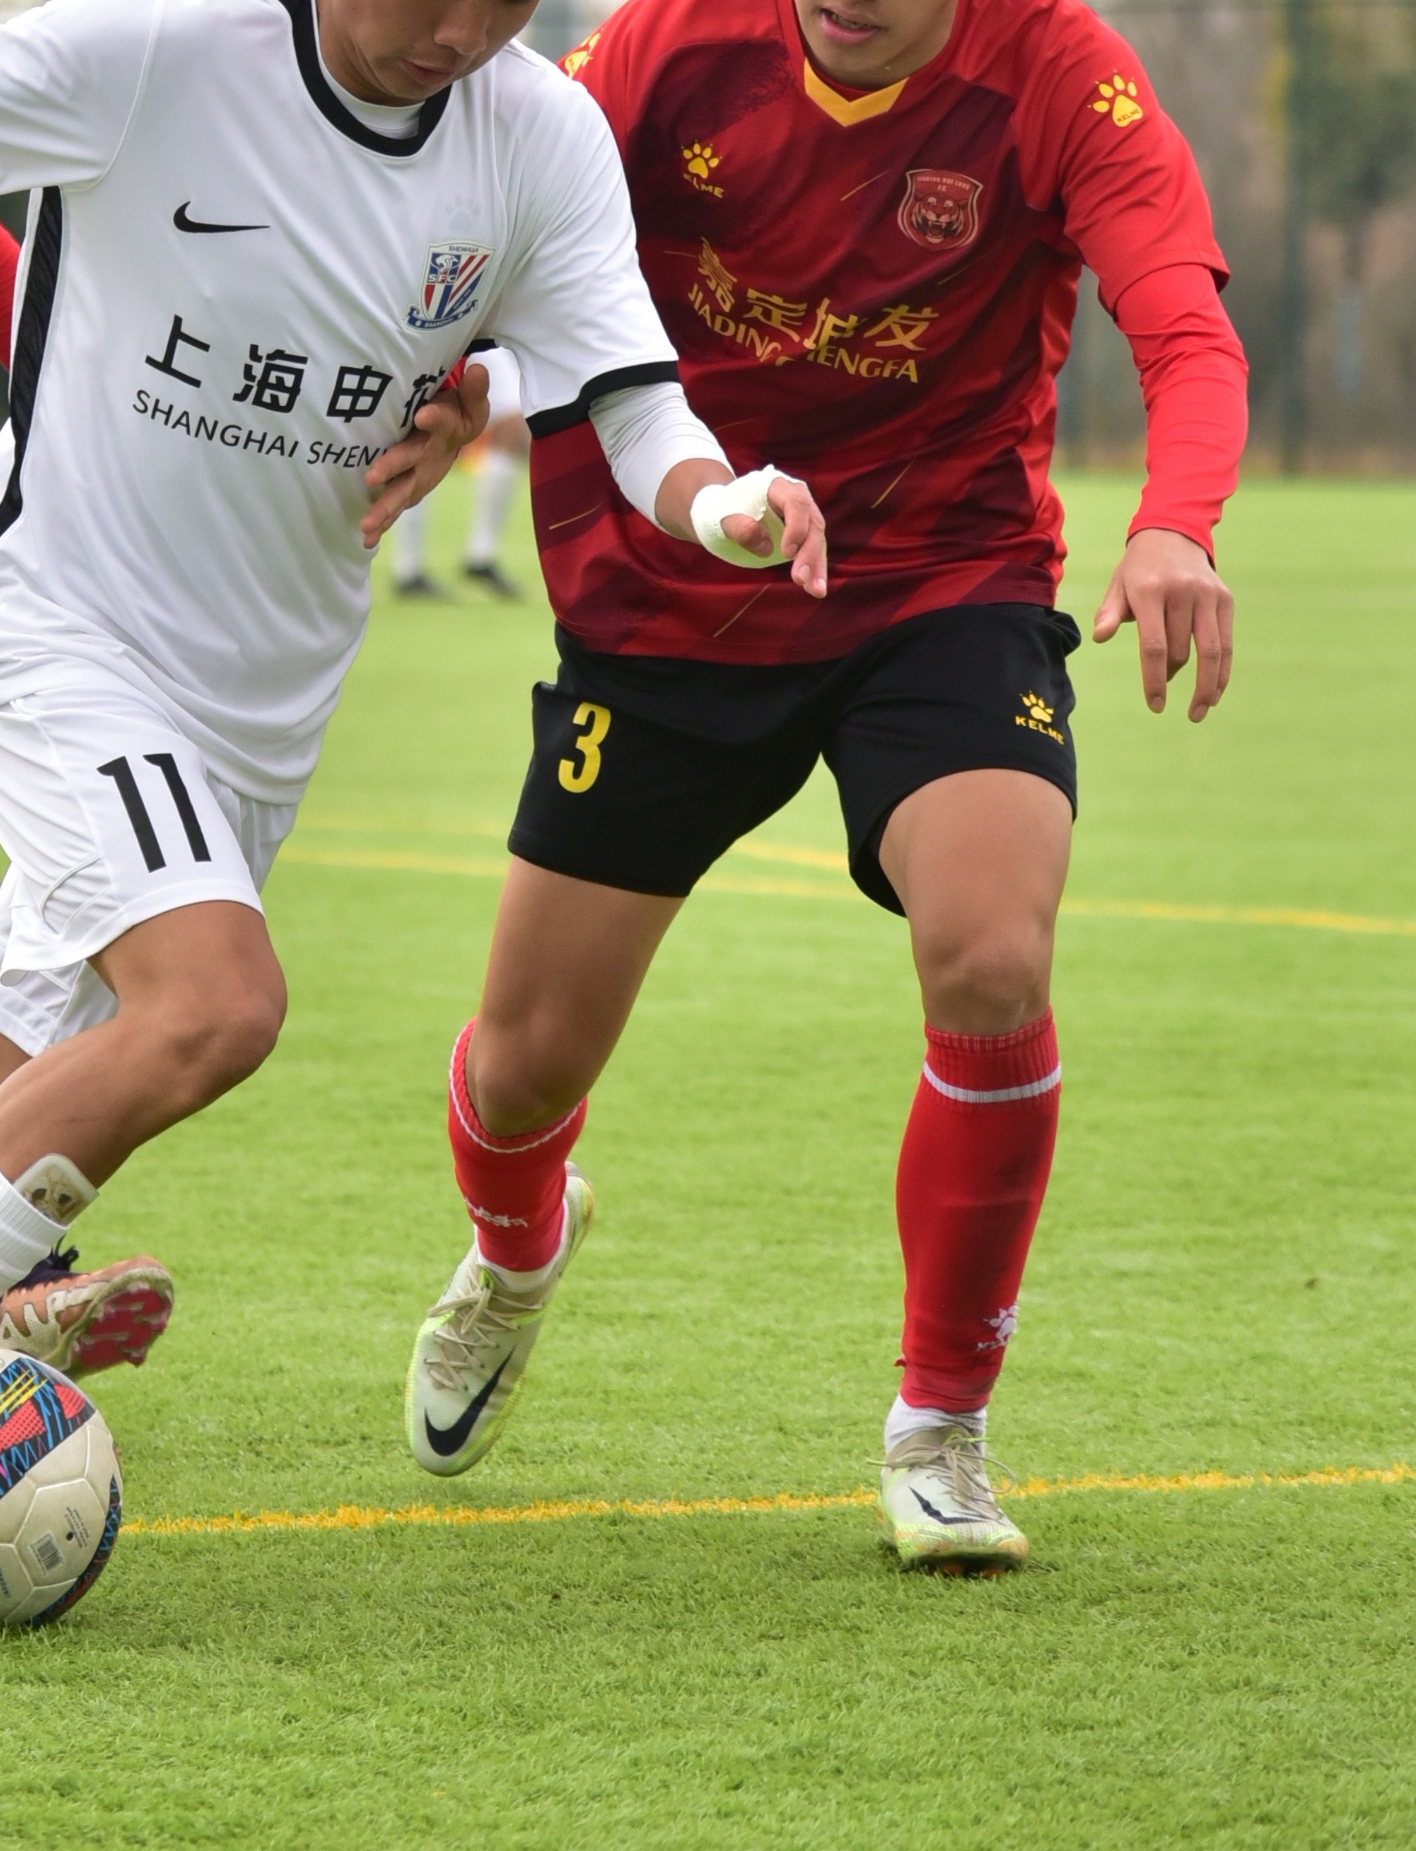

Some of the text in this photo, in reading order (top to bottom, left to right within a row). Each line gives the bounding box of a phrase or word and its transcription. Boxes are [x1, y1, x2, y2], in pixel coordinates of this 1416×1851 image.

[428, 274, 456, 283] SFC
[132, 389, 388, 469] SHANGHAI SHEN
[558, 701, 612, 793] 3
[1014, 715, 1065, 745] KELME
[96, 752, 212, 873] 11
